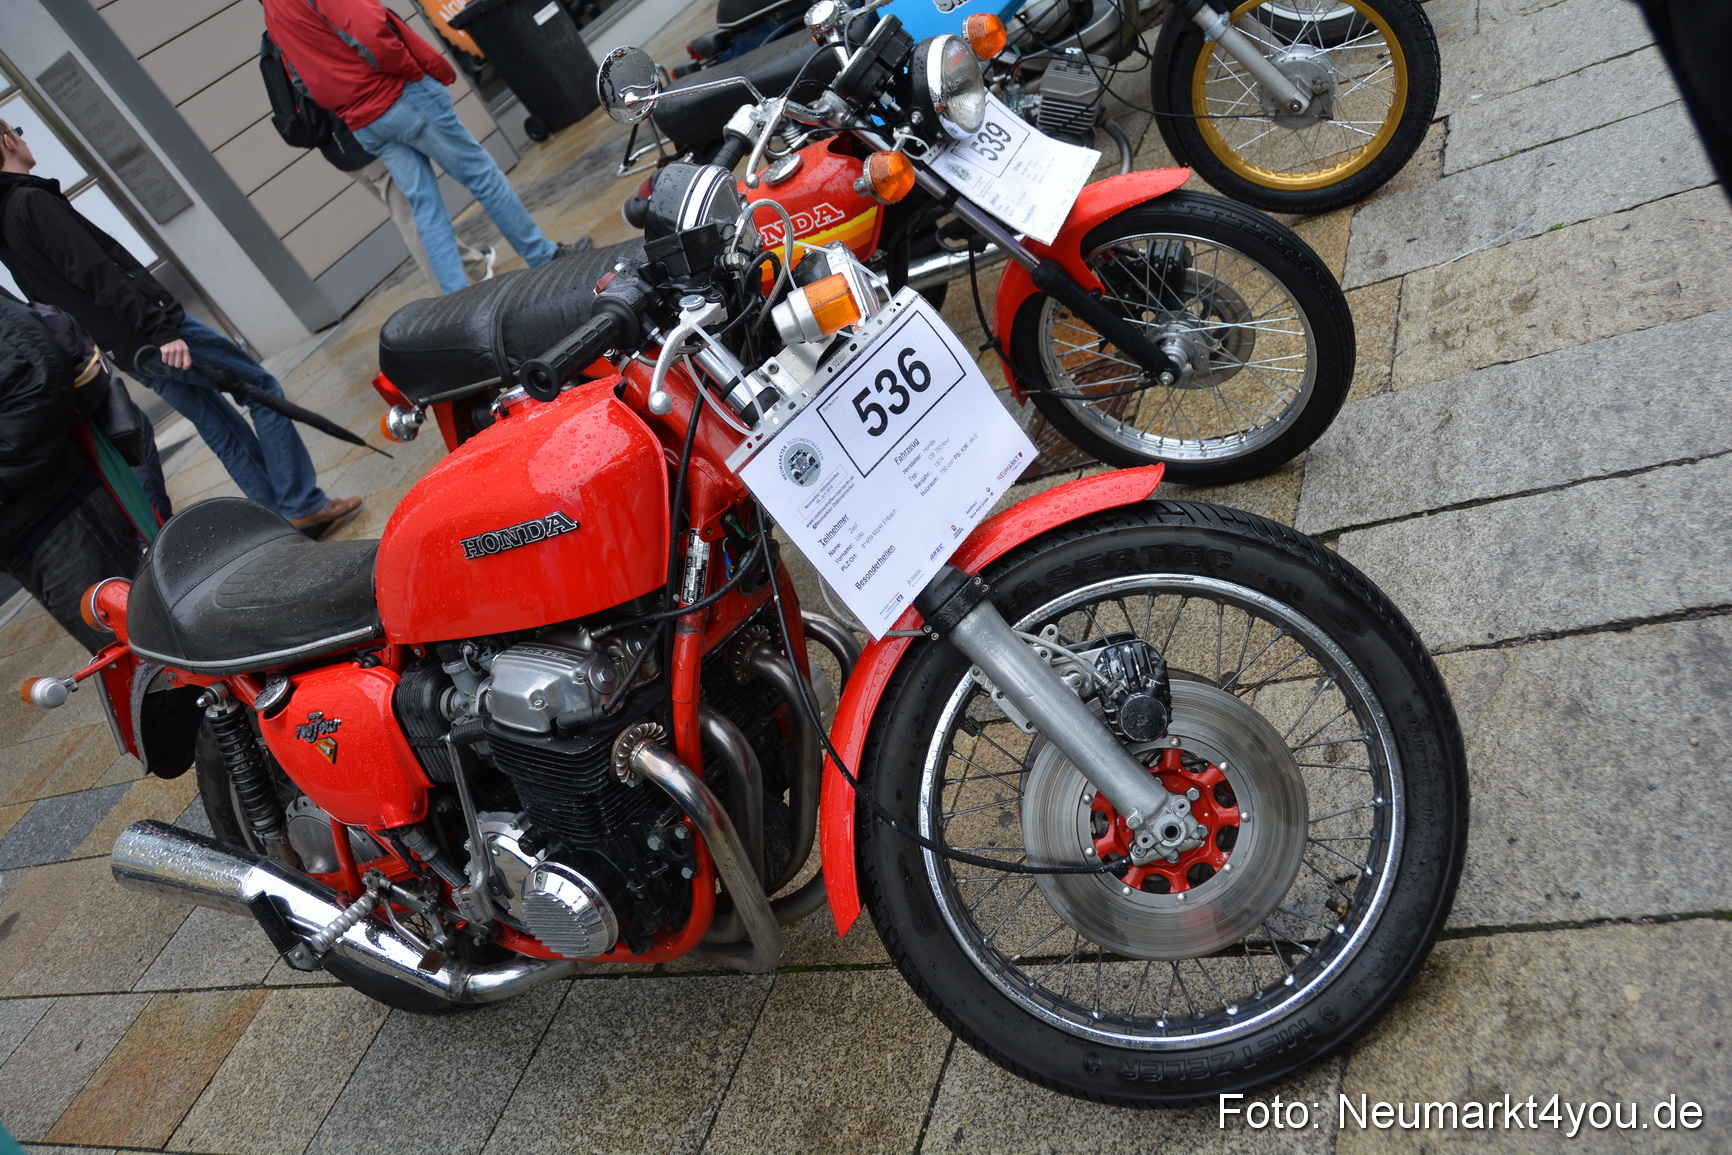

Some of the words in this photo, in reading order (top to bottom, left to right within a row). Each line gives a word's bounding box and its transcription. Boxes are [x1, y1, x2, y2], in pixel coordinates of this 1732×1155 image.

[970, 122, 1012, 160] 539
[760, 203, 845, 246] NDA
[852, 348, 931, 436] 536
[894, 438, 920, 465] Fahrzeug
[903, 453, 924, 474] Hersteller:
[923, 439, 936, 453] Honda
[908, 471, 919, 482] Typ:
[928, 452, 936, 461] CB
[934, 445, 943, 454] 750
[997, 456, 1020, 481] NEUMARKT
[914, 471, 932, 490] Baujahr:
[934, 457, 944, 467] 1974
[921, 476, 940, 497] Hubraum:
[460, 511, 578, 559] HONDA
[818, 514, 850, 547] Teilnehmer
[872, 524, 884, 536] Markt
[828, 542, 842, 557] Name:
[835, 543, 855, 564] Vorname:
[855, 545, 896, 590] Besonderheiten
[1120, 1021, 1312, 1080] METZELER
